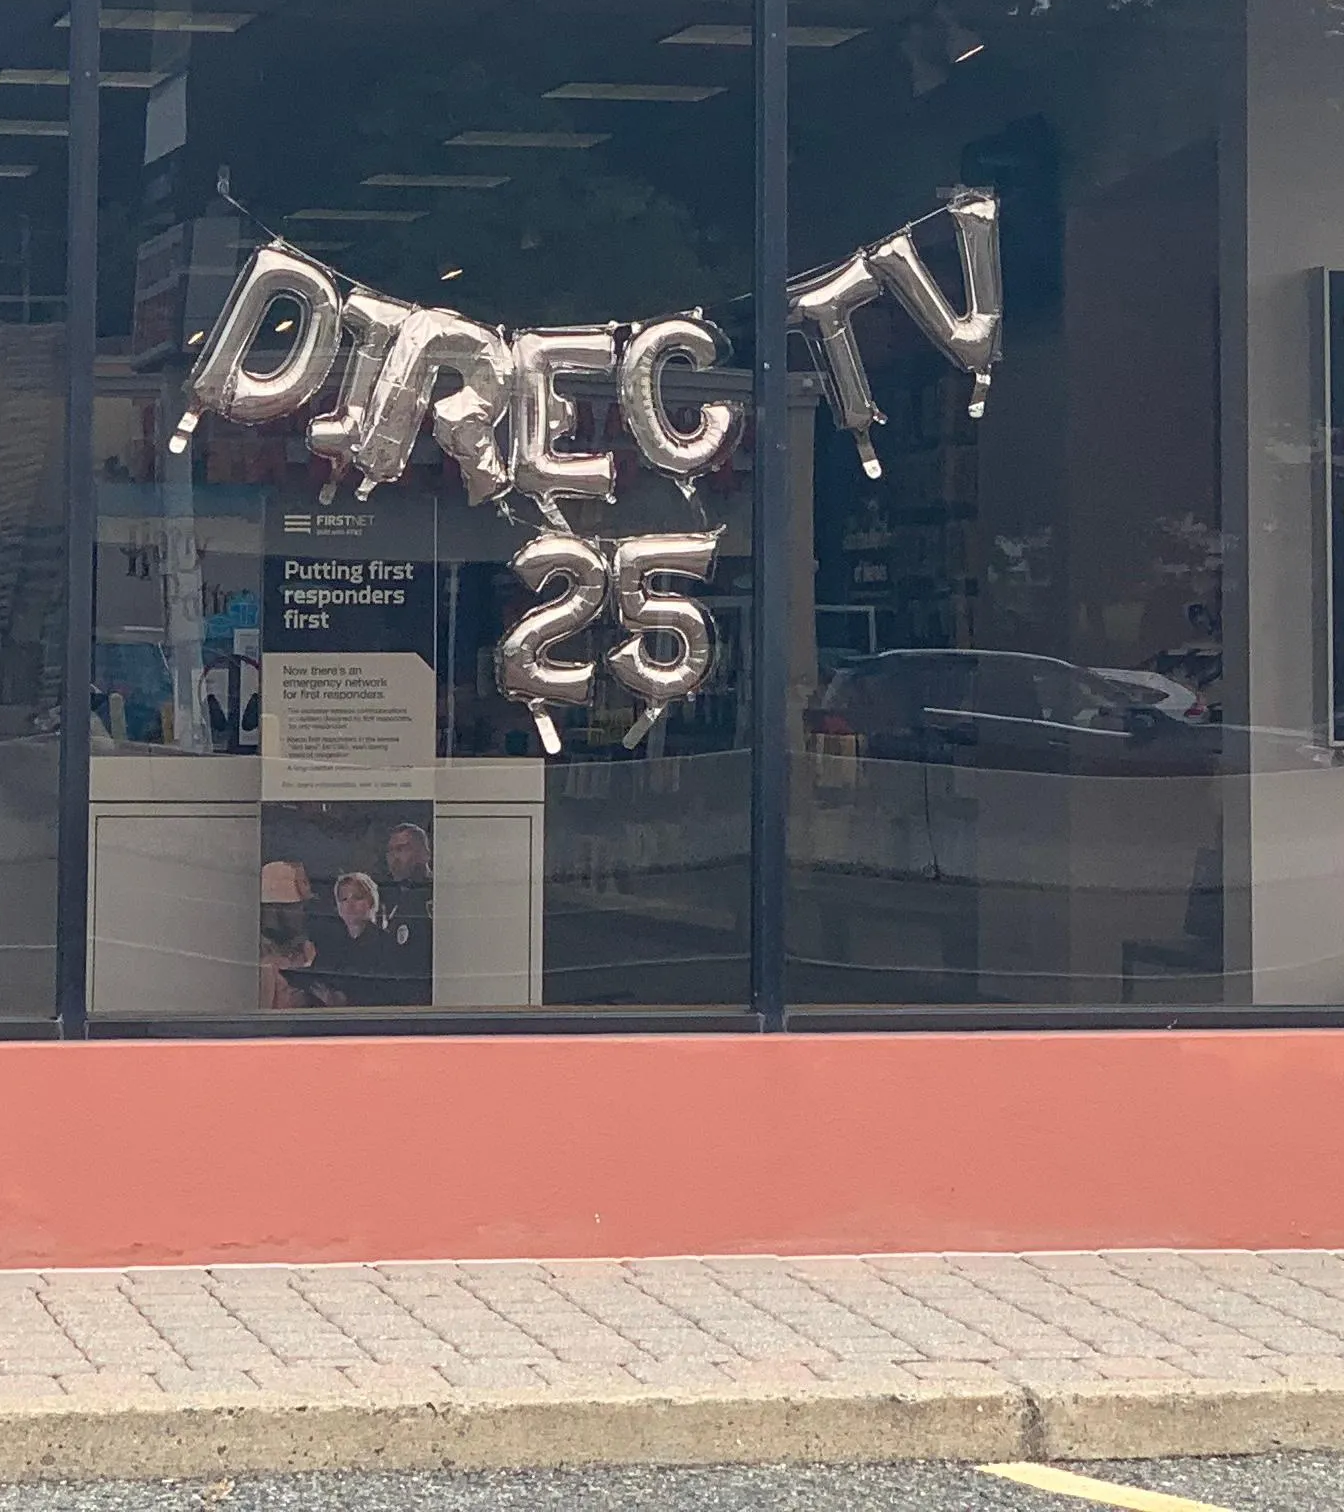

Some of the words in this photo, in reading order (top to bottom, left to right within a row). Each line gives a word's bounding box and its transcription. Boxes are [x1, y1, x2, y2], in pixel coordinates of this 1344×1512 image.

[316, 514, 375, 526] FIRSTNET
[285, 560, 363, 584] Putting
[368, 560, 414, 580] first
[284, 585, 405, 608] responders
[284, 609, 329, 629] first
[494, 529, 724, 710] 25
[283, 666, 307, 676] Now
[349, 667, 362, 676] an
[283, 679, 342, 690] emergency
[345, 677, 387, 688] network
[283, 689, 297, 700] for
[301, 689, 320, 700] first
